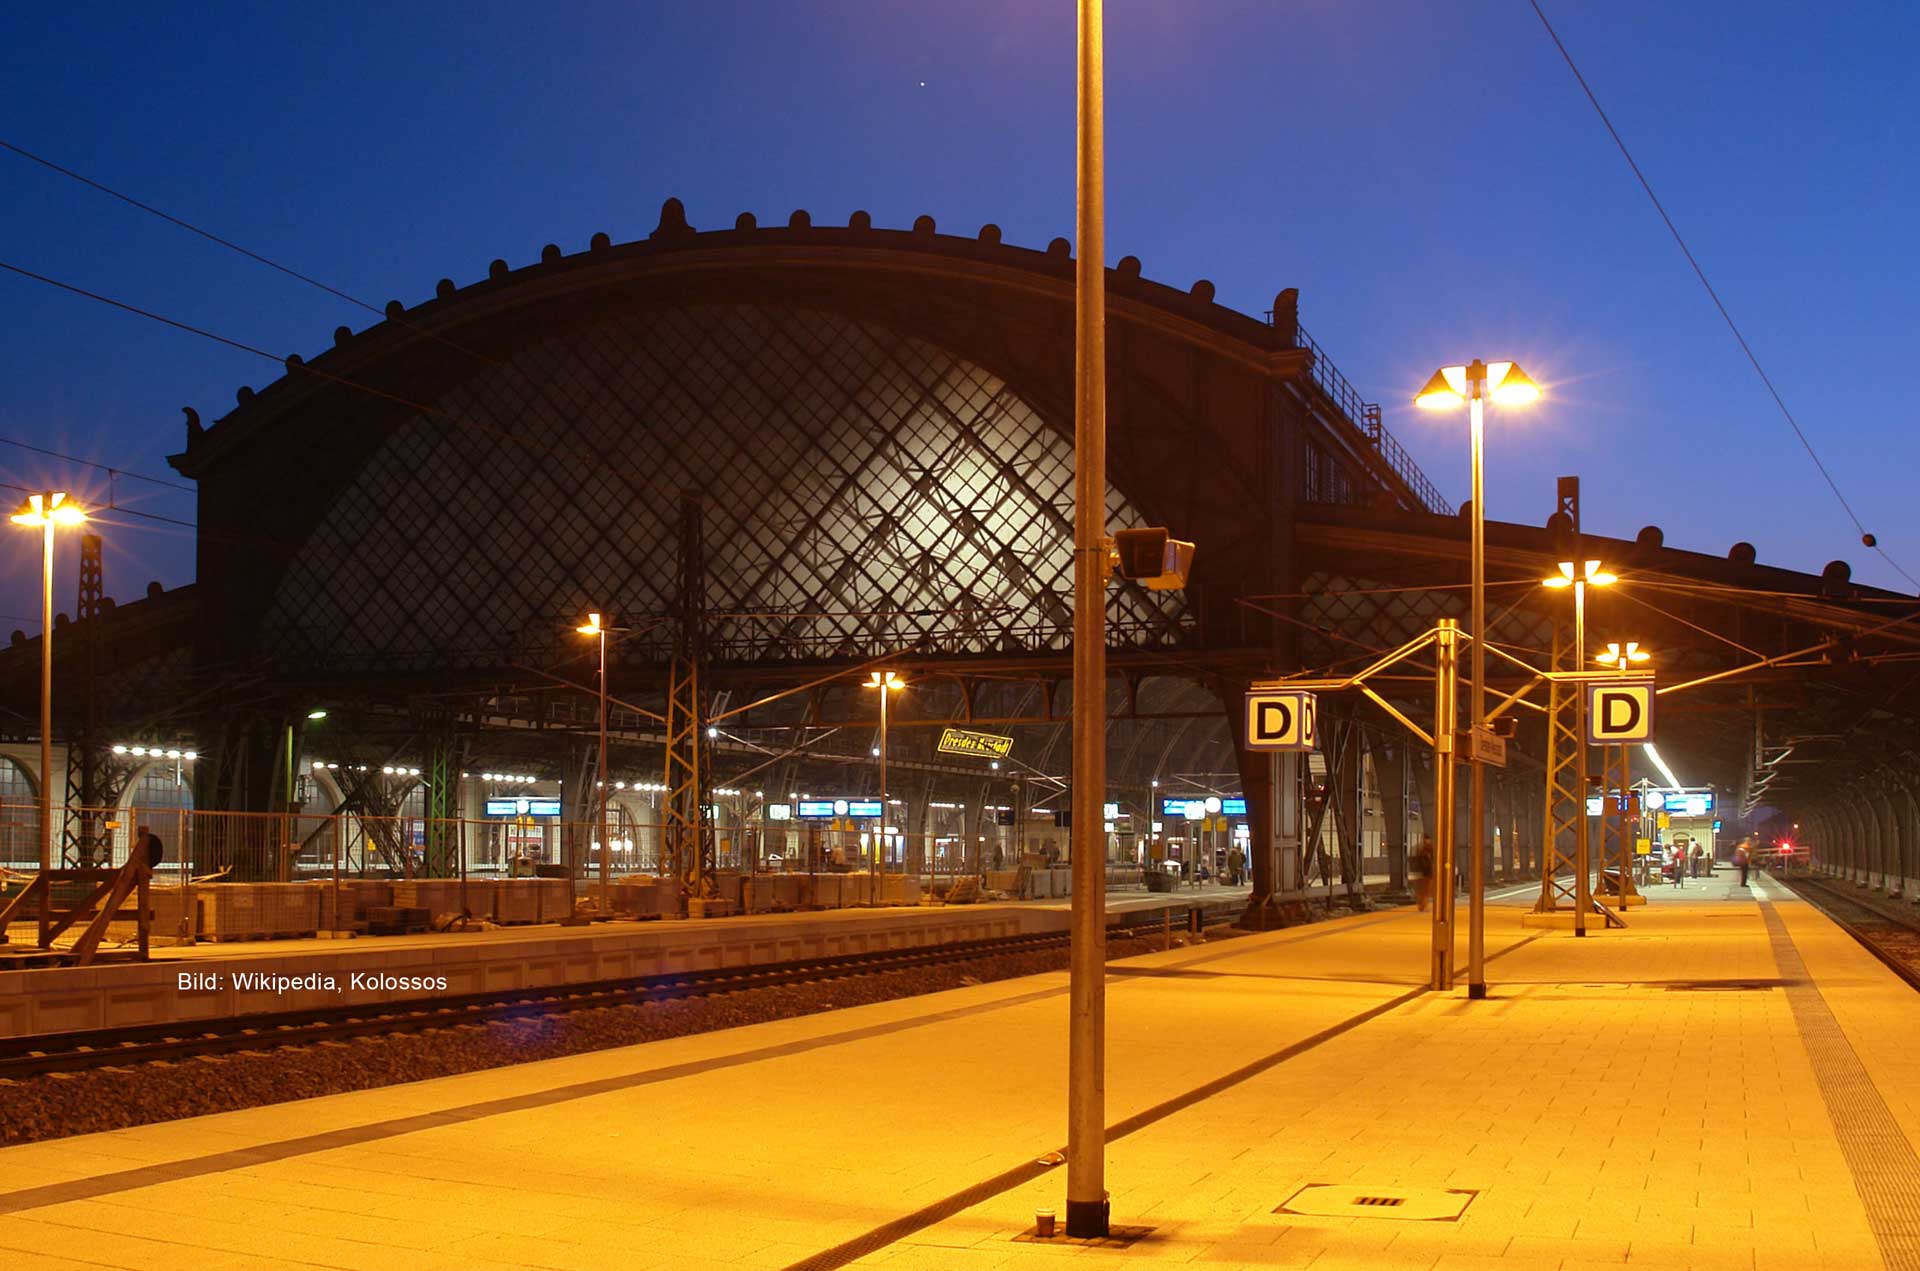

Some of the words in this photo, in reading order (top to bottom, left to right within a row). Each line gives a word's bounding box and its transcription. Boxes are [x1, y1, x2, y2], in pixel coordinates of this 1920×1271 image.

[1257, 701, 1291, 740] D
[1305, 702, 1313, 740] D
[1602, 692, 1640, 733] D
